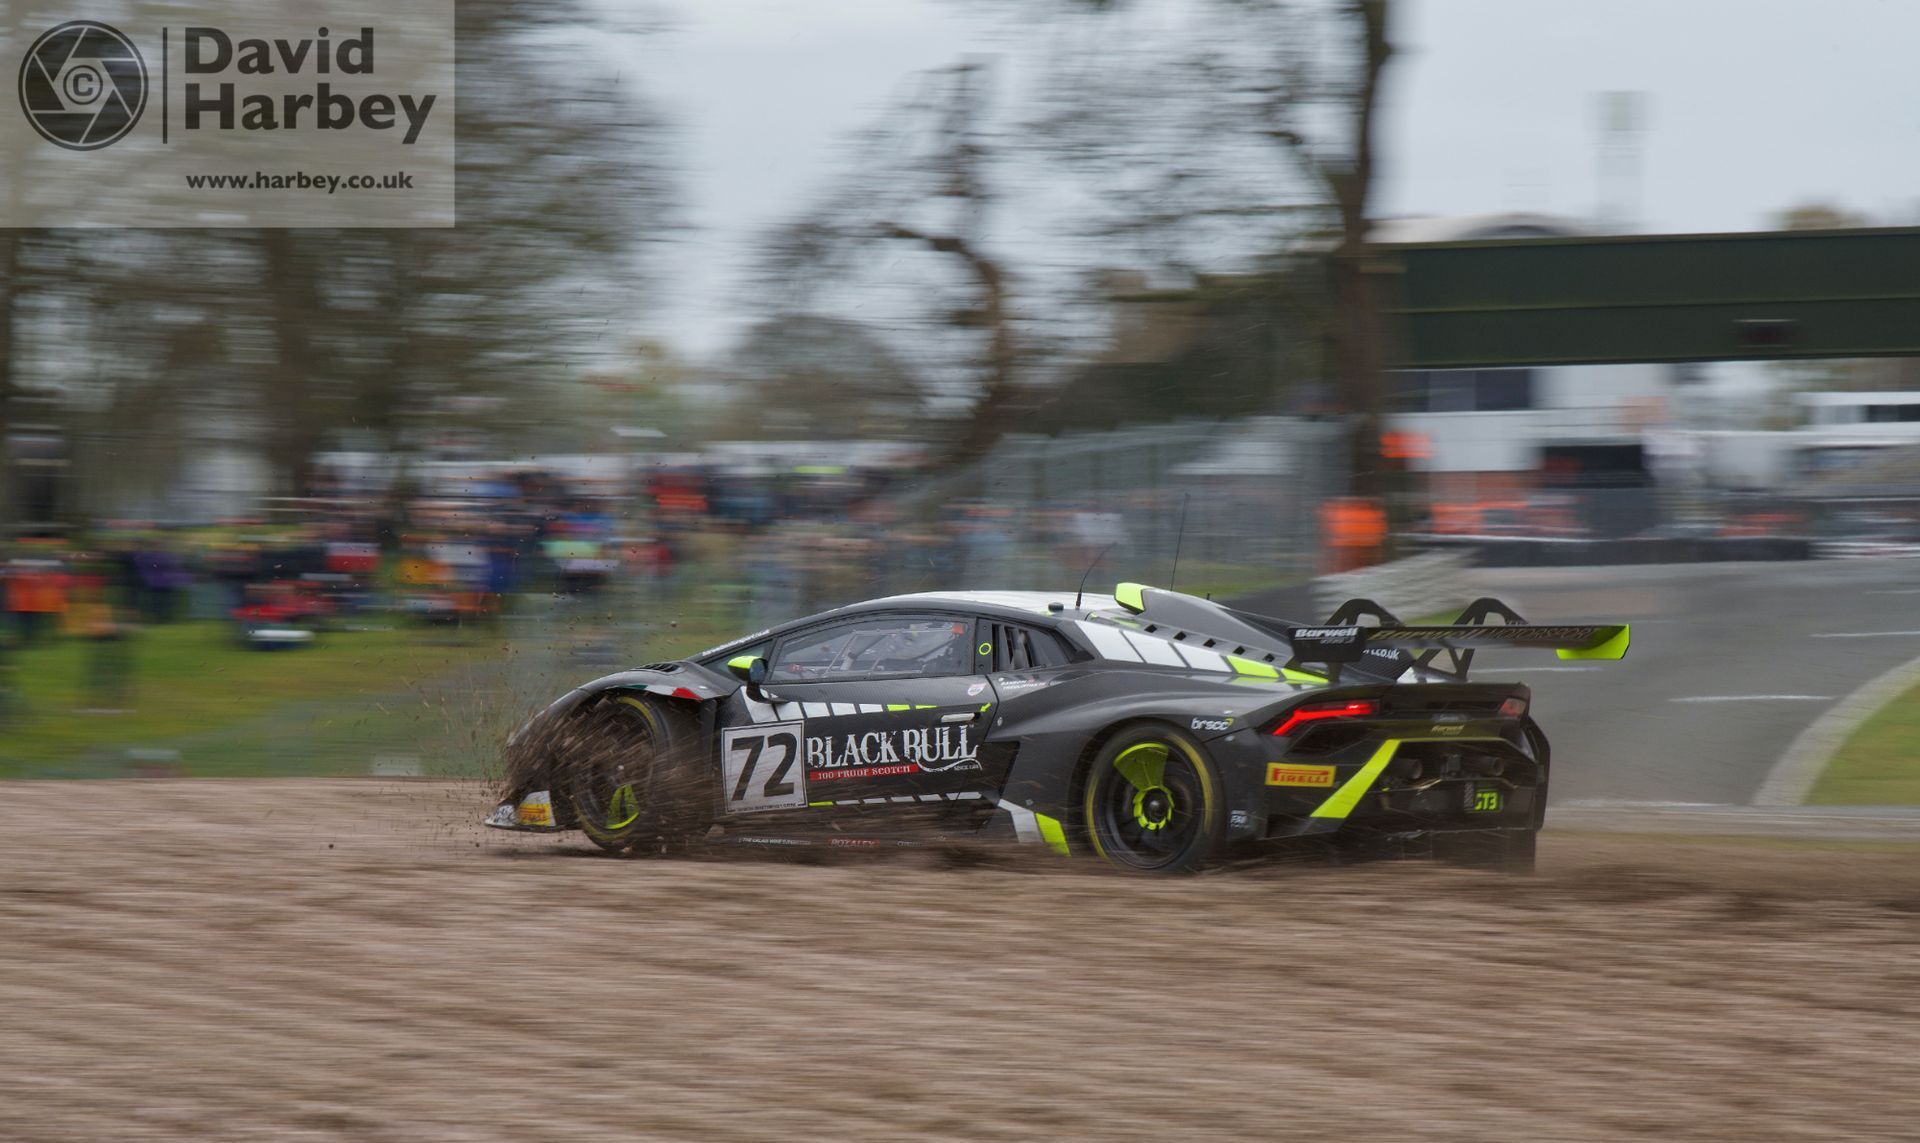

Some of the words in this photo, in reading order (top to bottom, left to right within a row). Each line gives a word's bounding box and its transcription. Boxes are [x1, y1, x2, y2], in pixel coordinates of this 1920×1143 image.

[1294, 626, 1359, 638] Barwell
[1191, 717, 1229, 730] brscc
[806, 731, 901, 769] BLACK
[903, 724, 979, 762] BULL
[731, 732, 798, 802] 72
[818, 770, 835, 780] 100
[837, 768, 870, 779] PROOF
[872, 765, 911, 776] SCOTCH
[1272, 768, 1330, 784] PIRELLI
